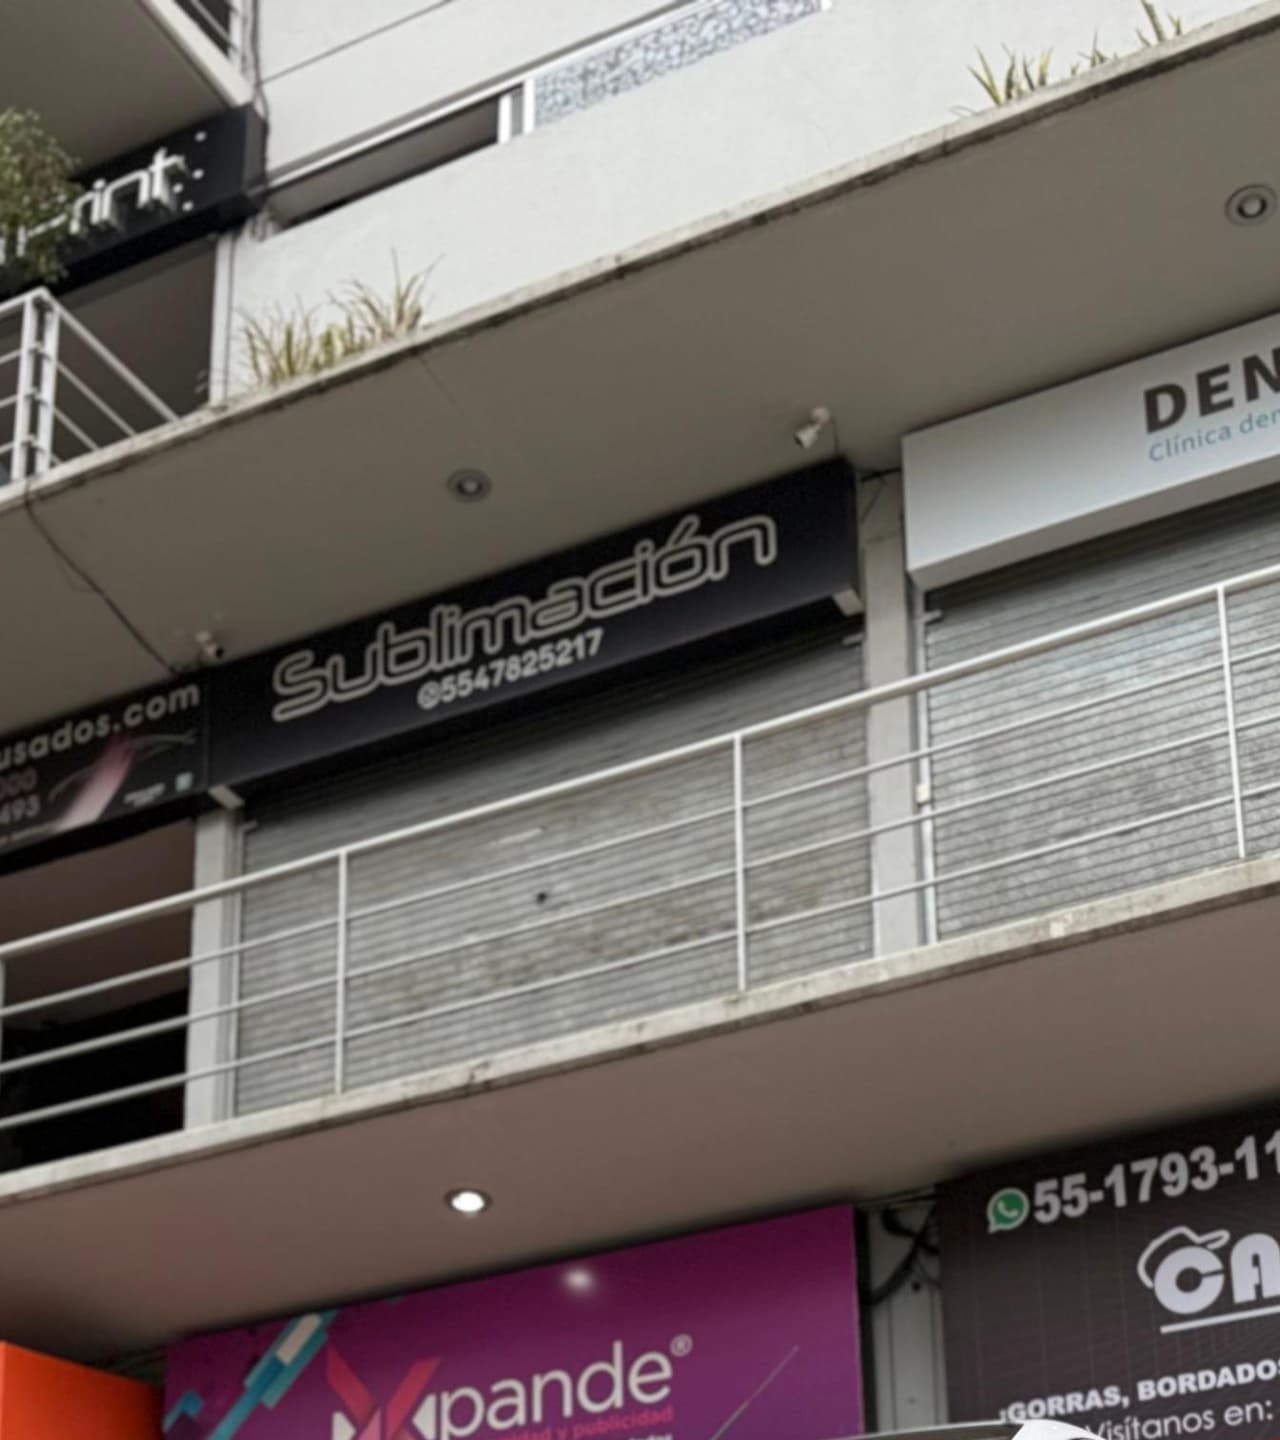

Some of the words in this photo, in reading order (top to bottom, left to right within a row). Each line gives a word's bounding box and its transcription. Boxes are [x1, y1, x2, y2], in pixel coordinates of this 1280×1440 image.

[1148, 425, 1233, 463] Clínica
[272, 514, 777, 722] Sublimación
[1223, 1397, 1273, 1427] en:
